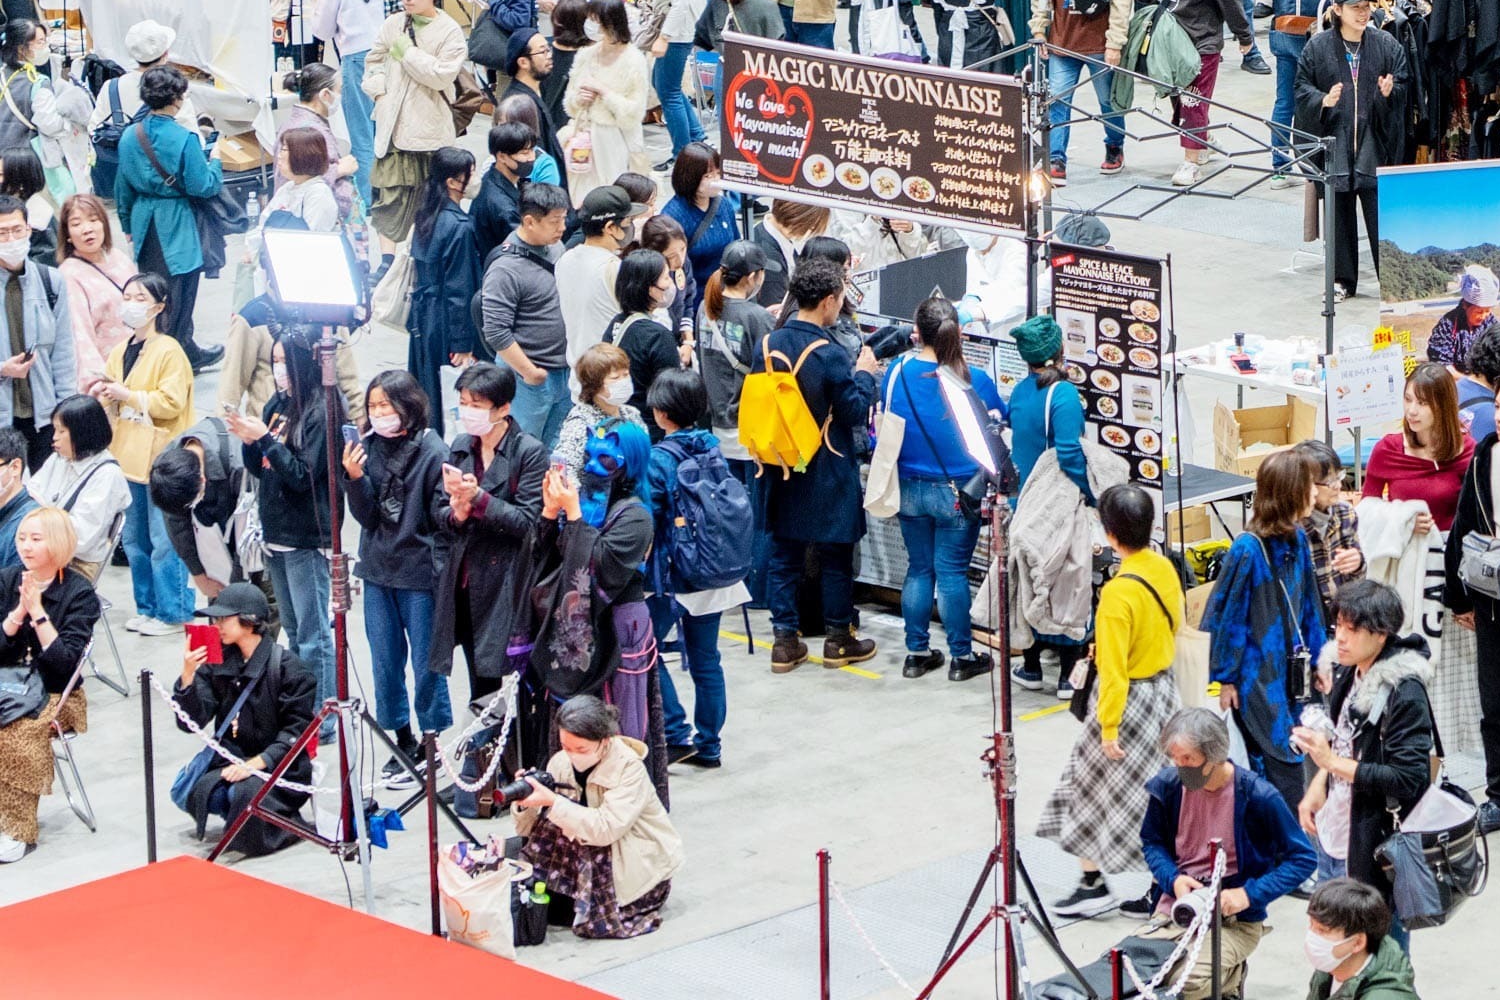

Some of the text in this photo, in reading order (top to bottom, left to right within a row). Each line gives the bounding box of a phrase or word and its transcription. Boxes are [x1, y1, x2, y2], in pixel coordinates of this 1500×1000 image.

[742, 50, 1003, 117] MAGIC MAYONNAISE
[735, 91, 786, 114] We love
[734, 111, 811, 140] Mayonnaise!
[734, 131, 805, 159] Very much!
[831, 138, 912, 171] 万能調味料
[1062, 265, 1151, 287] MAYONNAISE FACTORY
[1079, 258, 1101, 271] SPICE
[1102, 261, 1108, 272] &
[1109, 262, 1134, 276] PEACE
